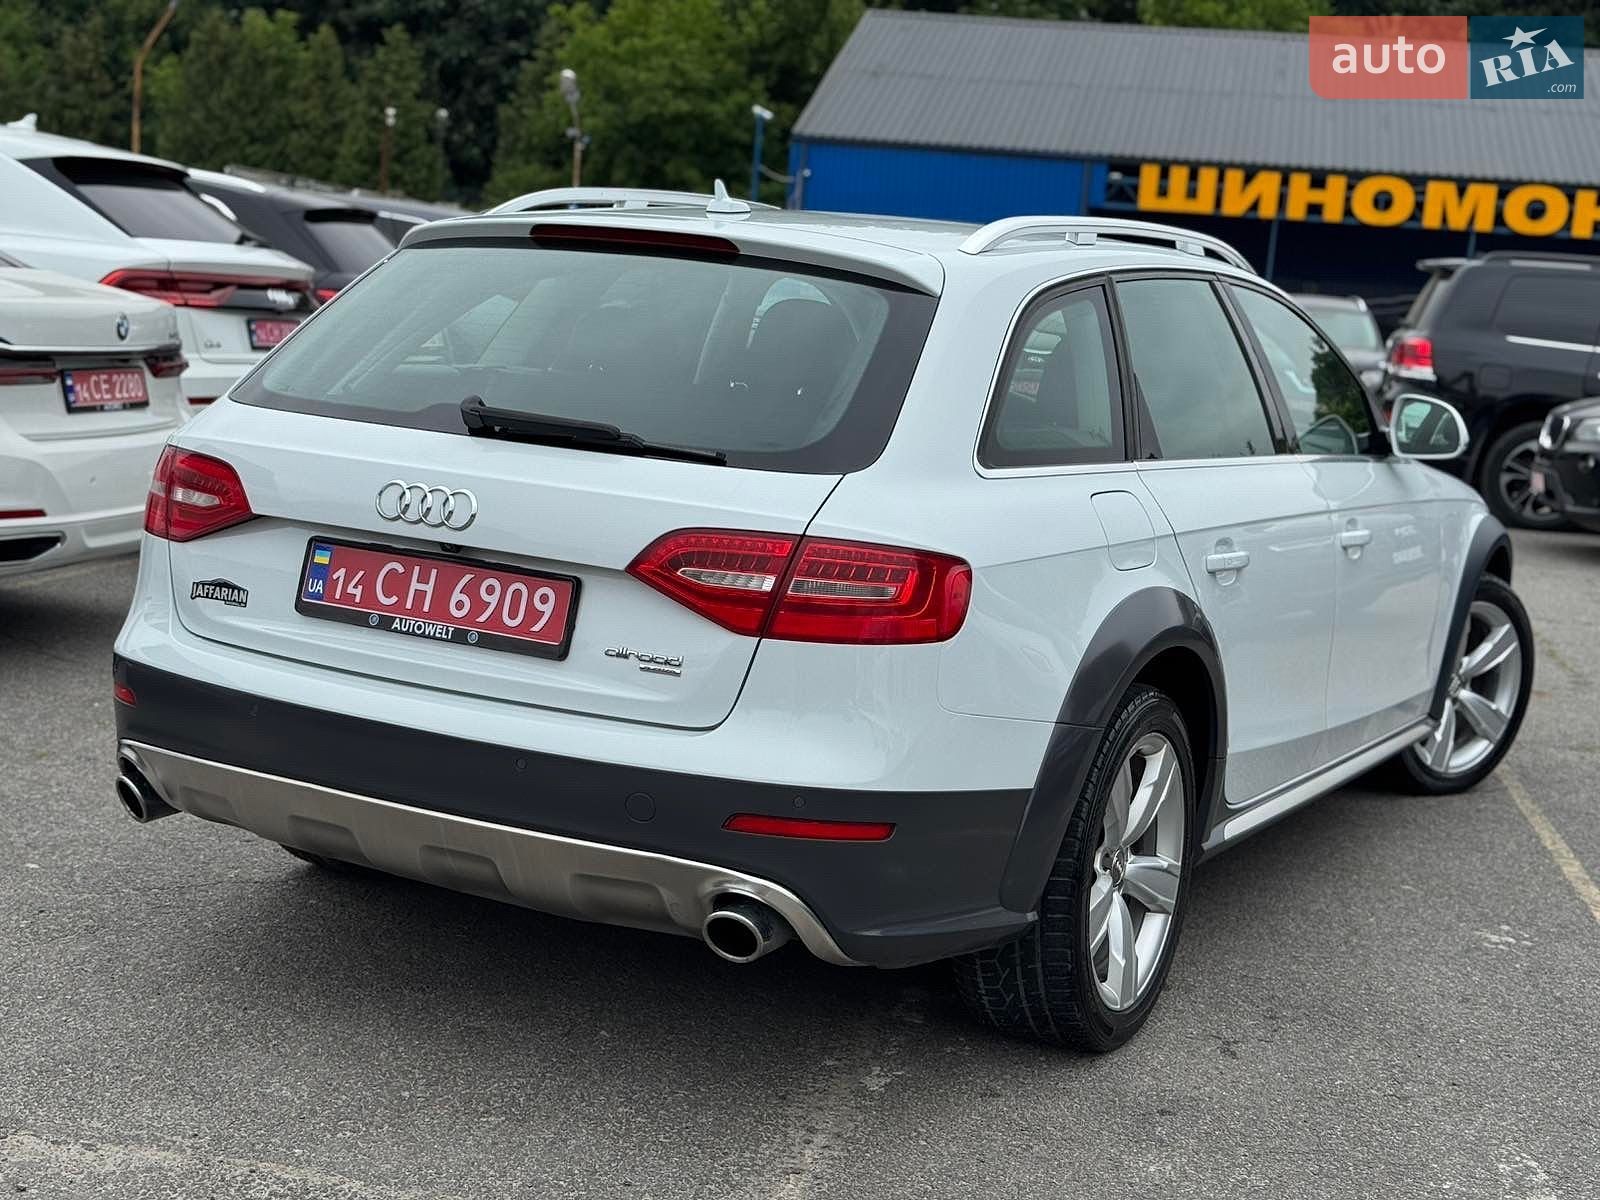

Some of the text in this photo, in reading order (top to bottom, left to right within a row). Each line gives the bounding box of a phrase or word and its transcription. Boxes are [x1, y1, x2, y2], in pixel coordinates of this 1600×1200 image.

[192, 583, 247, 603] JAFFARIAN
[308, 578, 324, 594] UA
[332, 561, 556, 632] 14 CH 6909
[391, 617, 454, 640] AUTOWELT
